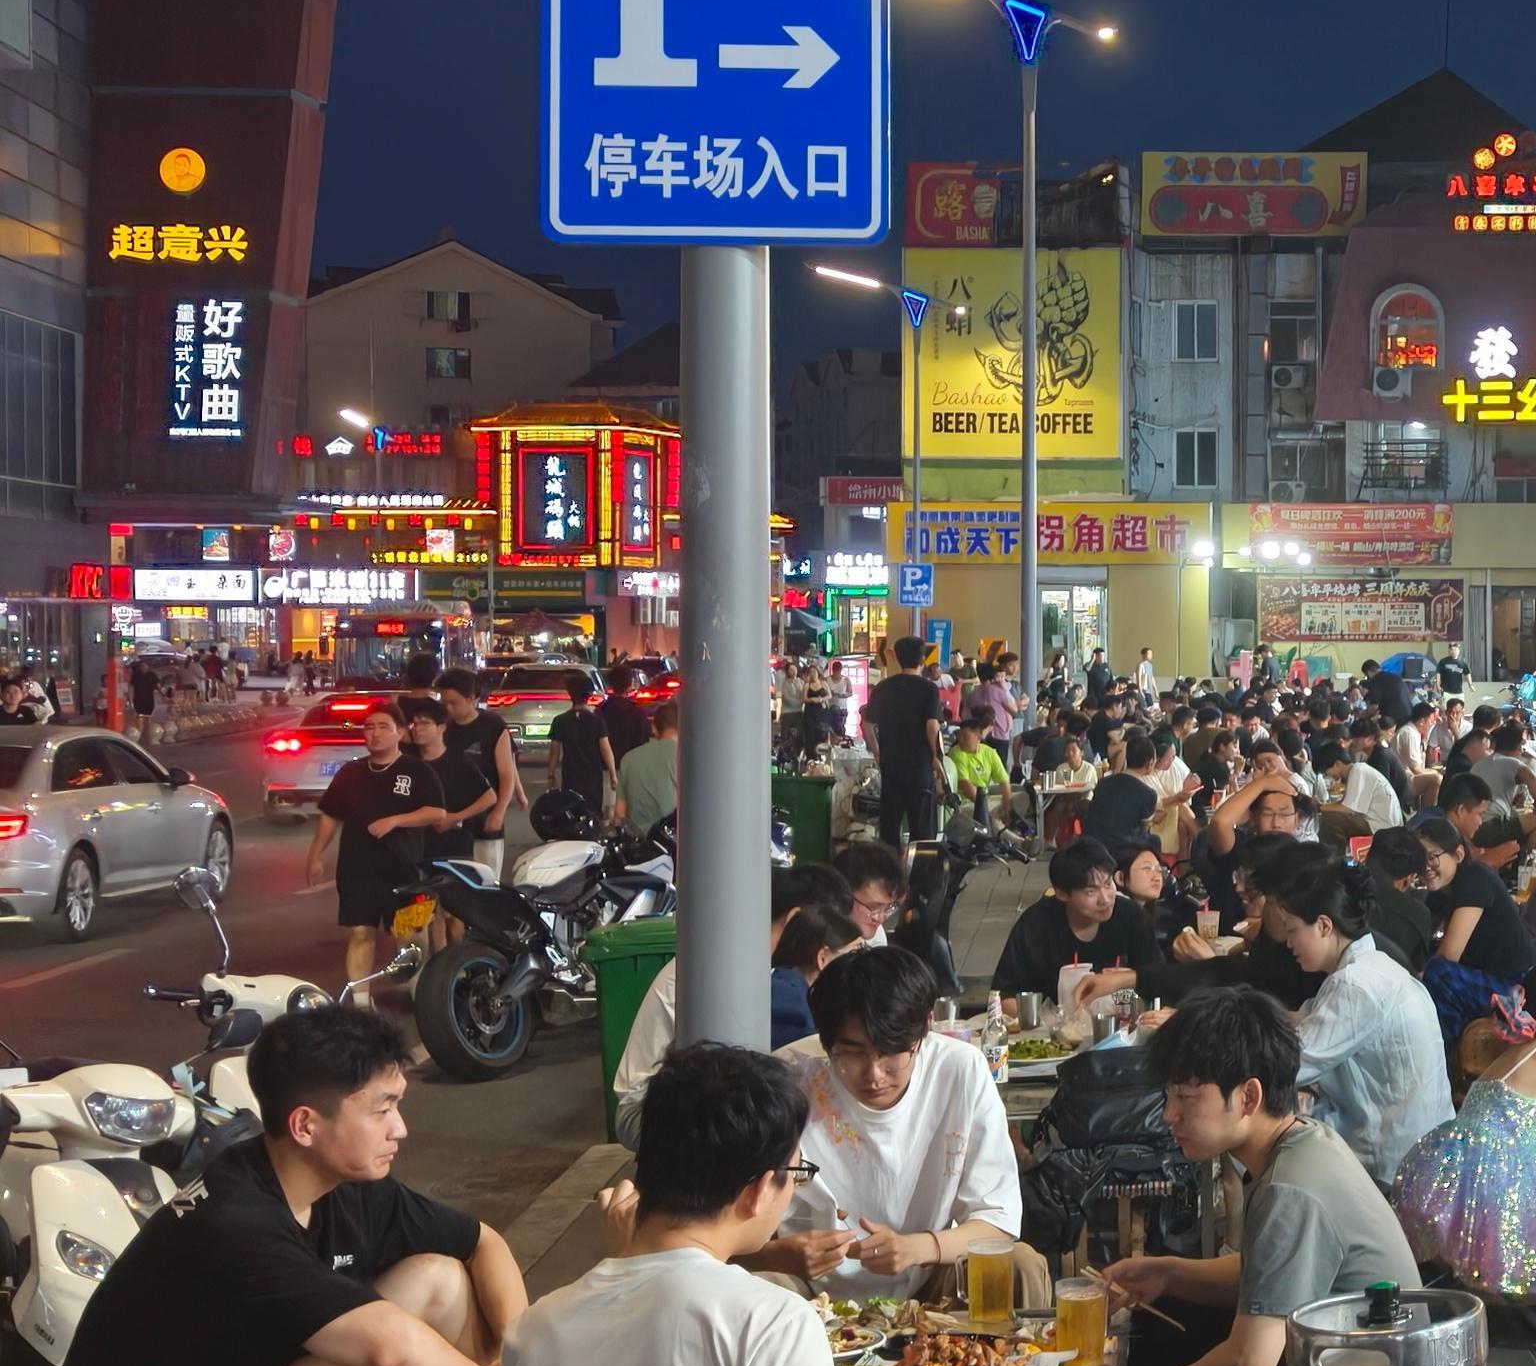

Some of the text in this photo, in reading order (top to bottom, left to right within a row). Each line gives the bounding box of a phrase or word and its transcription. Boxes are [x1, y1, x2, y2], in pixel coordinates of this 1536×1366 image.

[584, 132, 848, 200] 停车场入口
[108, 223, 249, 263] 超意兴
[174, 303, 195, 420] 量贩式KTV
[202, 298, 243, 422] 好歌曲
[1035, 512, 1192, 555] 拐角超市
[903, 567, 922, 591] P
